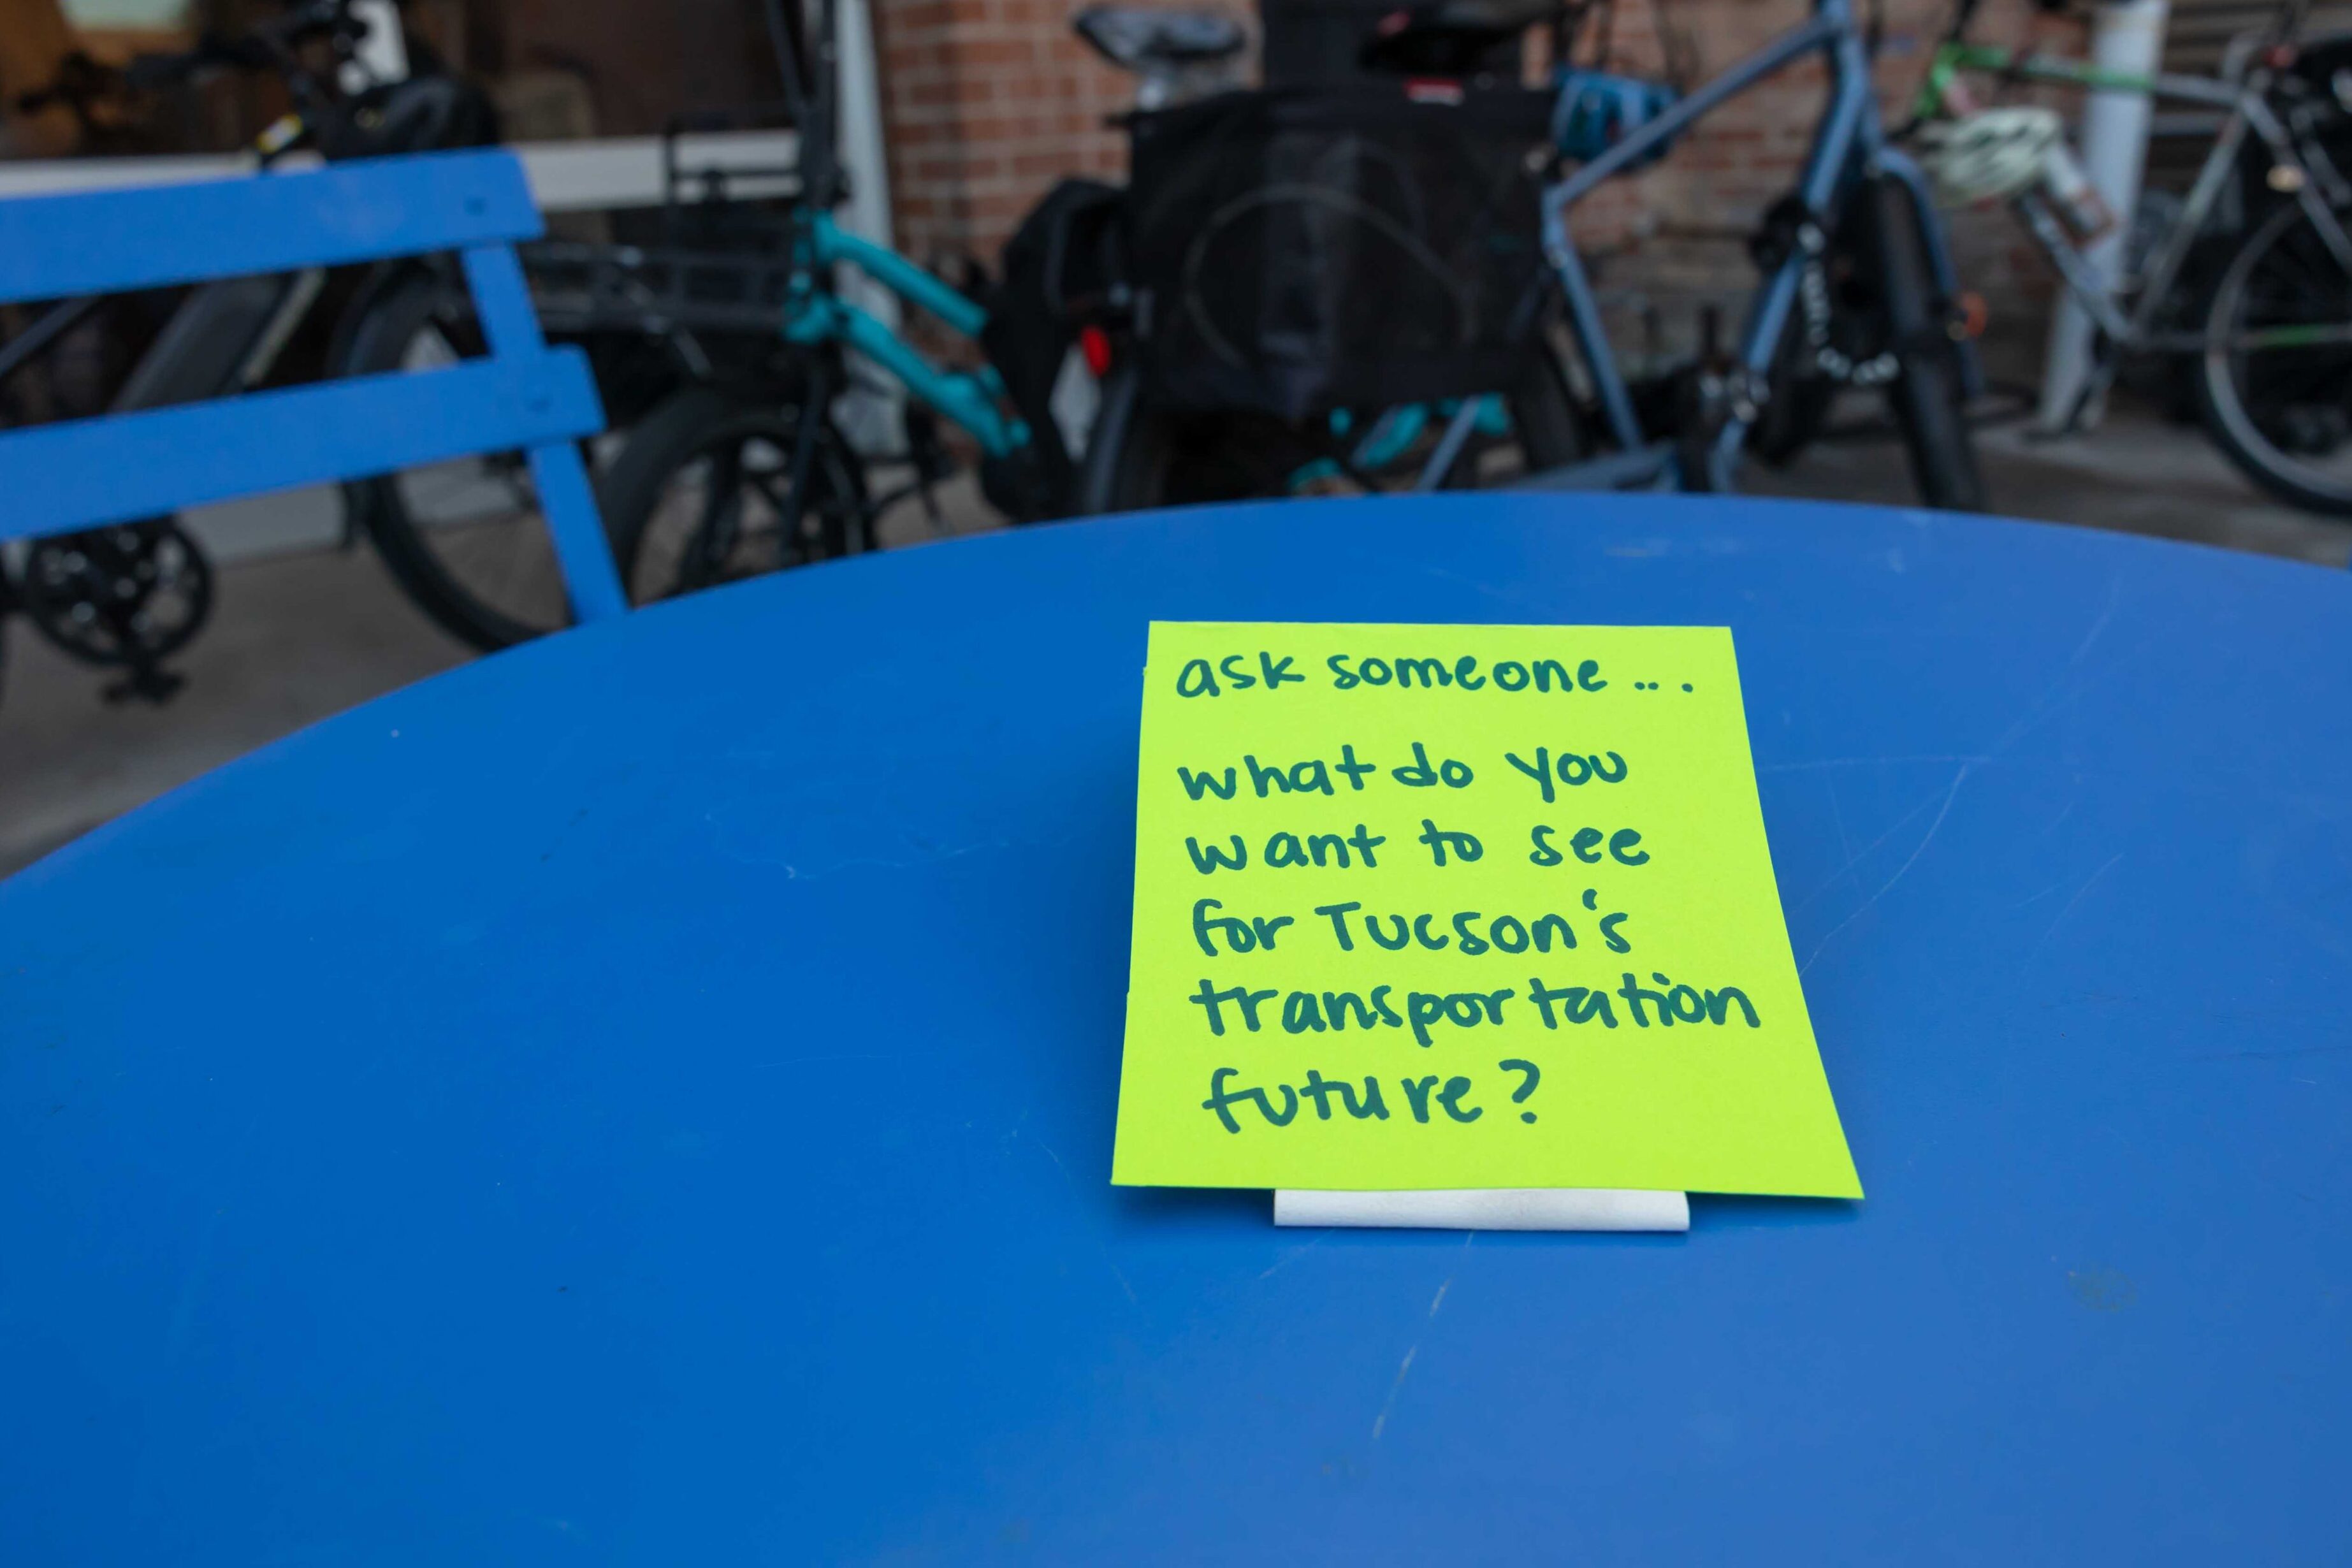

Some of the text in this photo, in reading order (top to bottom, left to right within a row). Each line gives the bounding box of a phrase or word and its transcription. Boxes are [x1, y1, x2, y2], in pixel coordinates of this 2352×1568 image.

[1177, 651, 1305, 697] ask
[1177, 742, 1627, 803] what do you
[1185, 819, 1650, 875] want to see
[1193, 889, 1631, 957] for Tucson's
[1189, 973, 1760, 1048] transportation
[1201, 1059, 1540, 1134] future?
